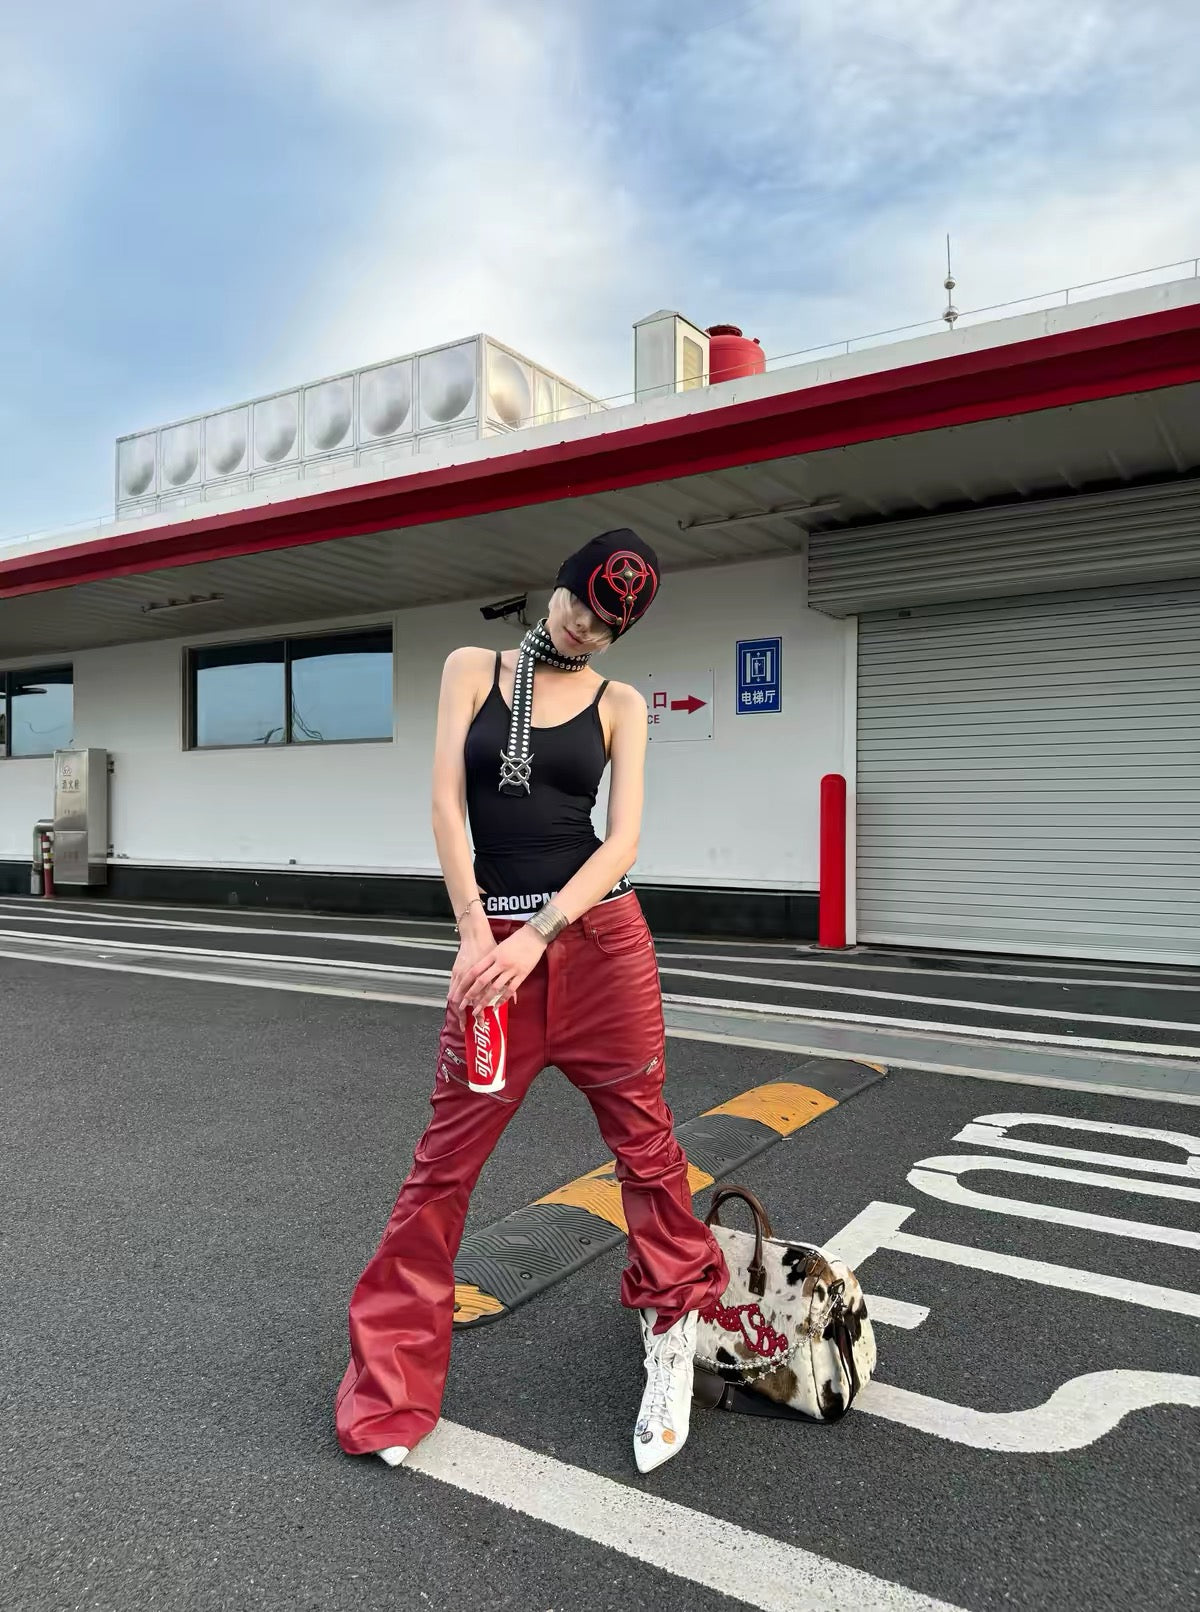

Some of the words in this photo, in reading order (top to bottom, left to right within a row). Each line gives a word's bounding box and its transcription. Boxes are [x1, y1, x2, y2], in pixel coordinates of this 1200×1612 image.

[647, 692, 667, 708] 口
[741, 690, 776, 705] 电梯厅
